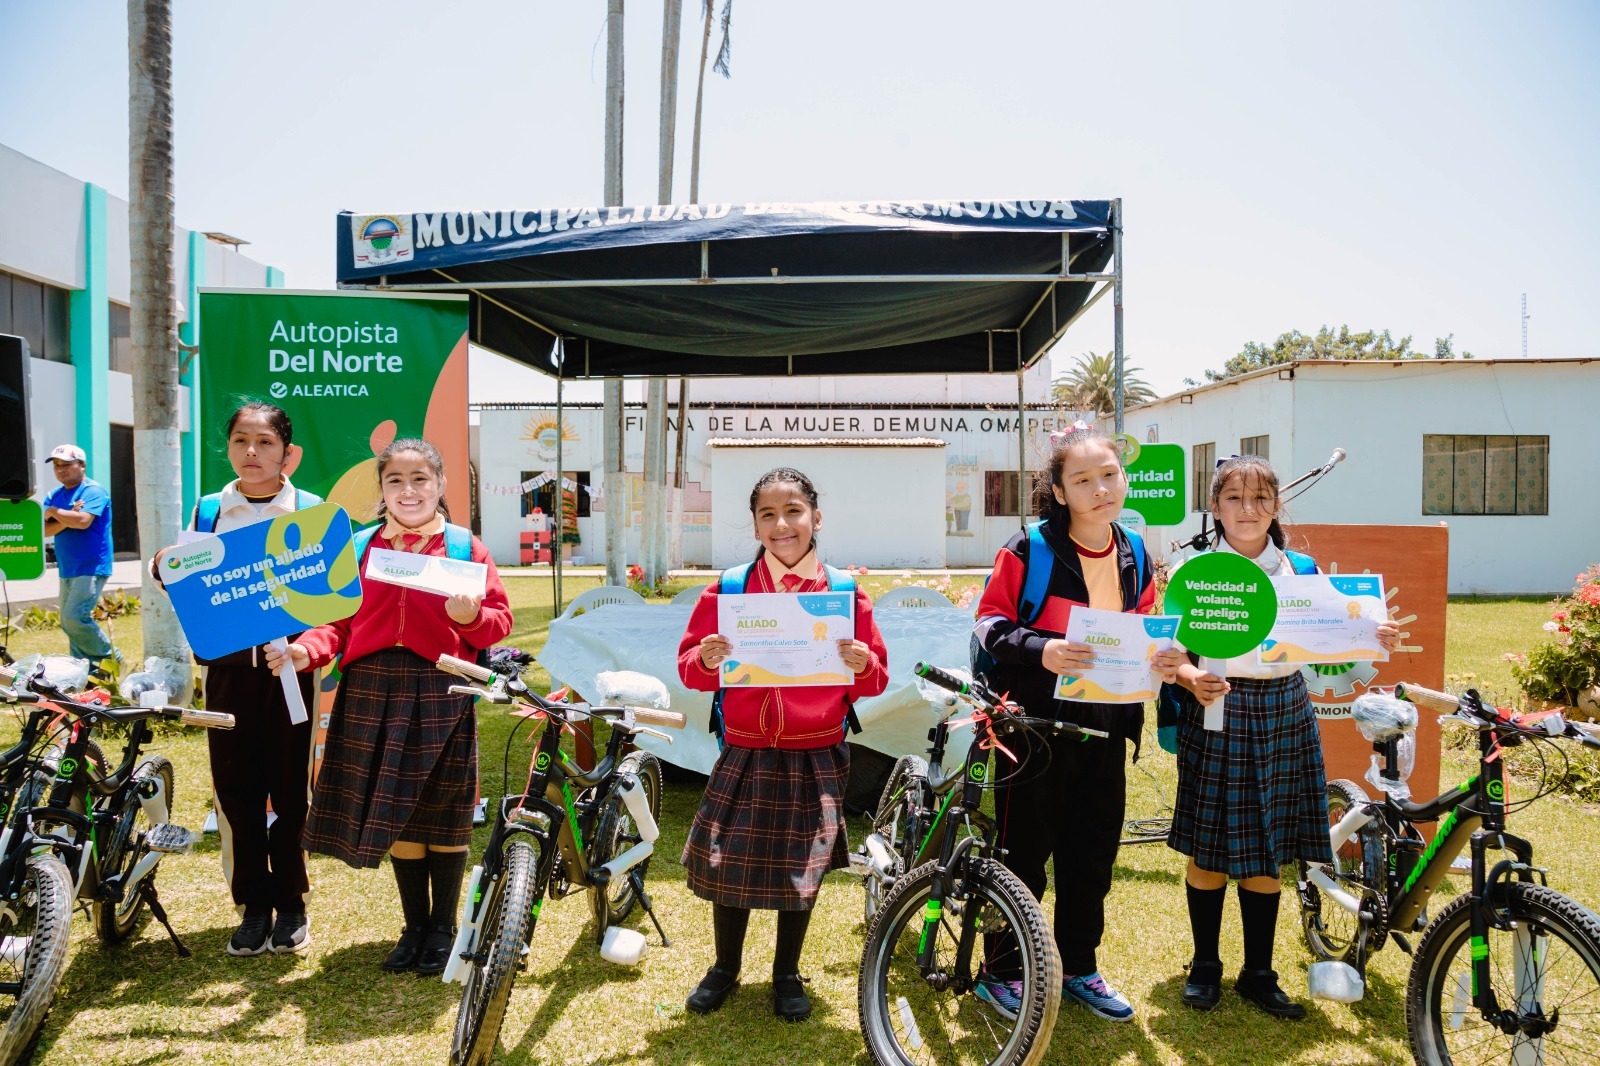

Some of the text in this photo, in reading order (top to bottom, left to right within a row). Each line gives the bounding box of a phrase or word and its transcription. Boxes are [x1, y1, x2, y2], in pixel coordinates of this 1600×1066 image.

[270, 320, 398, 348] Autopista
[269, 349, 403, 373] Del Norte
[292, 384, 369, 396] ALEATICA
[709, 417, 733, 431] DE
[745, 417, 772, 431] LA
[1126, 470, 1174, 482] uridad
[1128, 487, 1176, 498] imero
[0, 545, 38, 553] identes
[182, 550, 212, 564] Autopista
[184, 557, 212, 570] del Norte
[200, 542, 324, 588] Yo soy un aliado
[383, 567, 420, 577] ALIADO
[210, 560, 327, 606] de la seguridad
[1185, 580, 1258, 593] Velocidad al
[258, 591, 289, 611] vial
[1195, 593, 1245, 606] volante,
[1190, 607, 1249, 620] es peligro
[736, 619, 778, 629] ALIADO
[1189, 621, 1249, 632] constante
[1084, 634, 1121, 647] ALIADO
[1313, 706, 1352, 716] AMON
